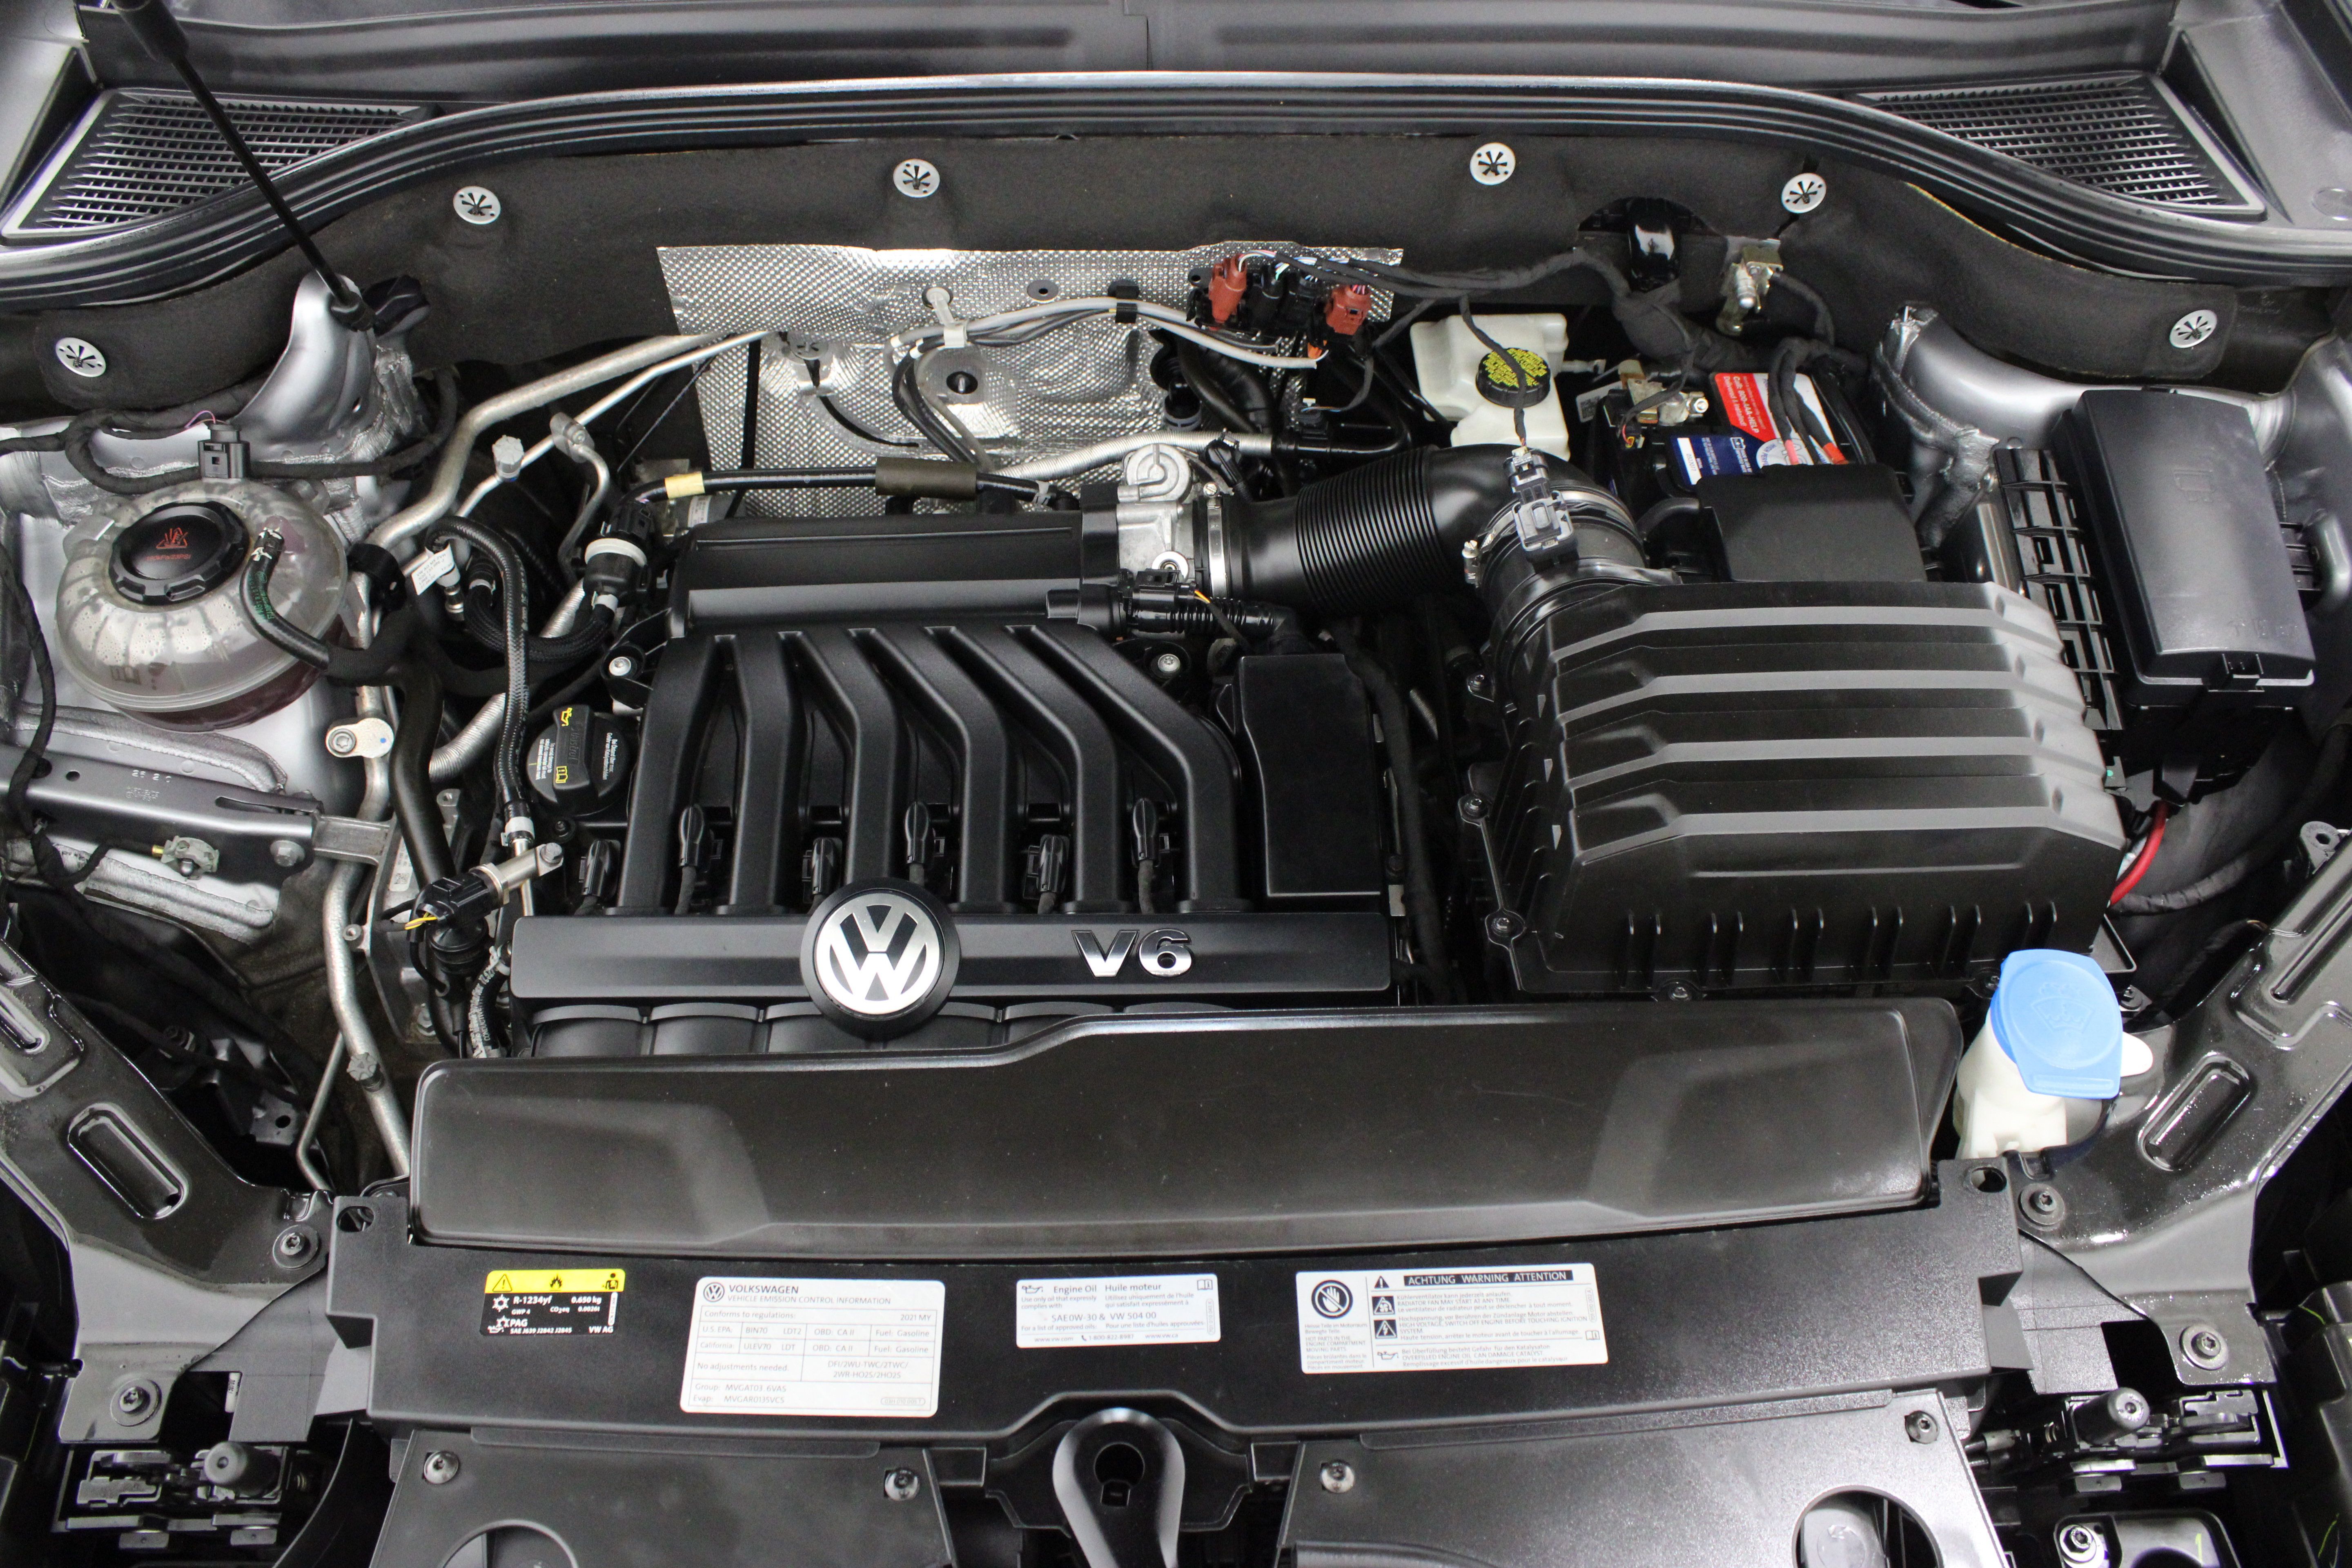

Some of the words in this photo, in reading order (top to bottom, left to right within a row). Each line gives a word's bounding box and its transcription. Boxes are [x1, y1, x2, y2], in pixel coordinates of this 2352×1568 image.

[1071, 928, 1195, 978] V6
[1408, 1275, 1455, 1285] ACHTUNG
[1461, 1273, 1508, 1284] WARNING
[1514, 1271, 1566, 1281] ATTENTION
[729, 1285, 799, 1294] VOLKSWAGEN
[1054, 1285, 1082, 1295] Engine
[1105, 1284, 1127, 1292] Huile
[513, 1295, 552, 1306] R-1234yf
[571, 1296, 591, 1304] 0.650
[592, 1295, 601, 1305] kg
[752, 1311, 795, 1320] regulations:
[510, 1318, 528, 1327] PAG
[710, 1363, 757, 1372] adjustments
